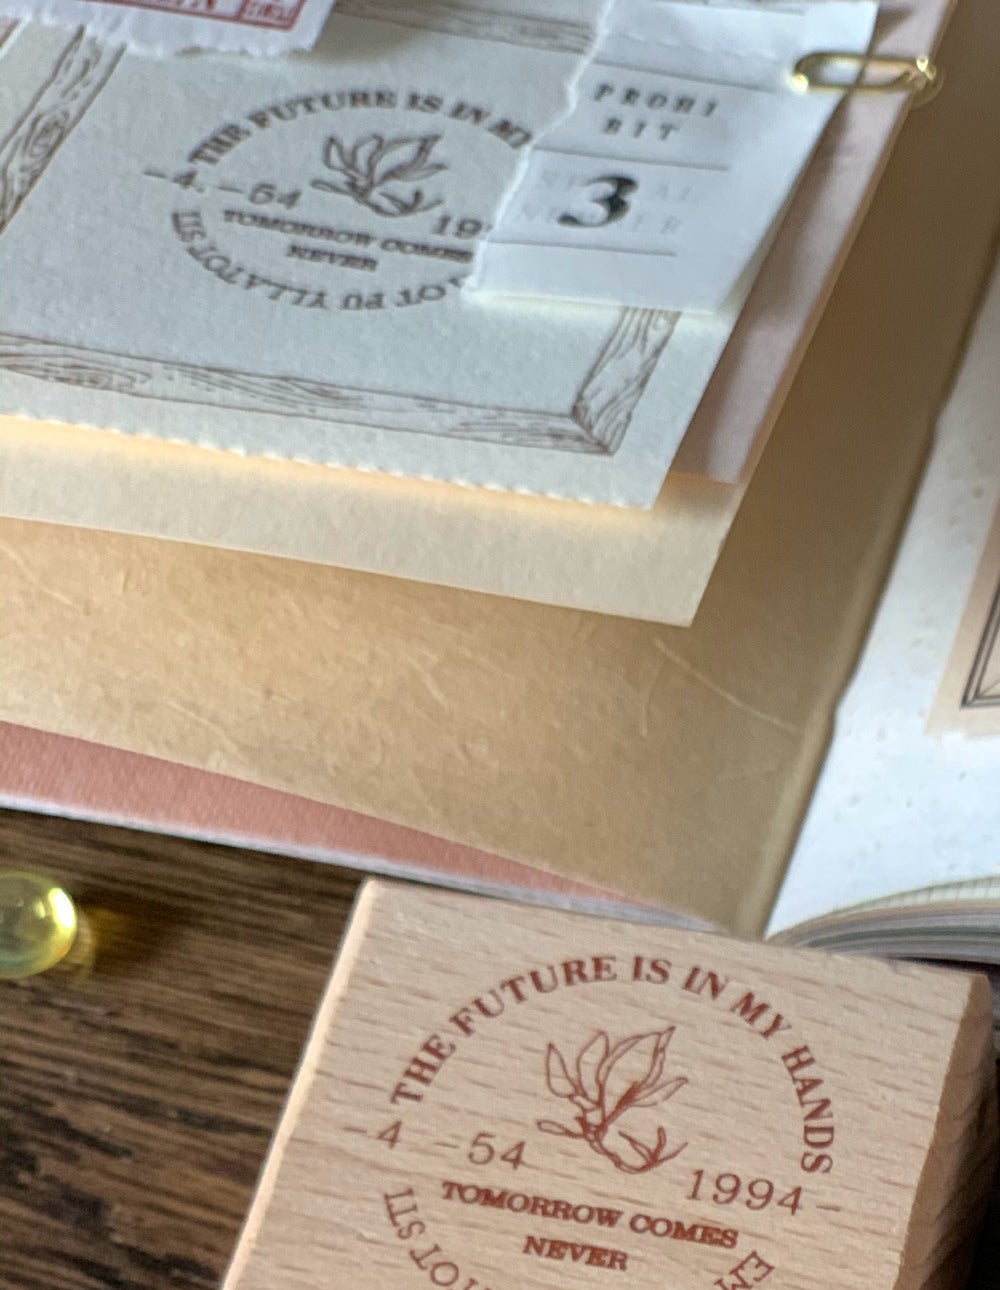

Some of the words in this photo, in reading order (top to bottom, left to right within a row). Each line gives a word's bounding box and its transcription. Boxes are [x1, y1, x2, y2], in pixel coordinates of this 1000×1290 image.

[187, 124, 252, 165] THE
[247, 92, 397, 129] FUTURE
[405, 93, 443, 114] IS
[557, 172, 639, 227] 3
[223, 209, 376, 246] TOMORROW
[380, 238, 475, 264] COMES
[287, 244, 378, 272] NEVER
[391, 1034, 457, 1106] THE
[449, 956, 618, 1037] FUTURE
[631, 956, 672, 984] IS
[684, 966, 731, 1001] IN
[731, 988, 793, 1040] MY
[781, 1045, 835, 1174] HANDS
[441, 1180, 623, 1228] TOMORROW
[629, 1214, 739, 1249] COMES
[522, 1236, 629, 1271] NEVER
